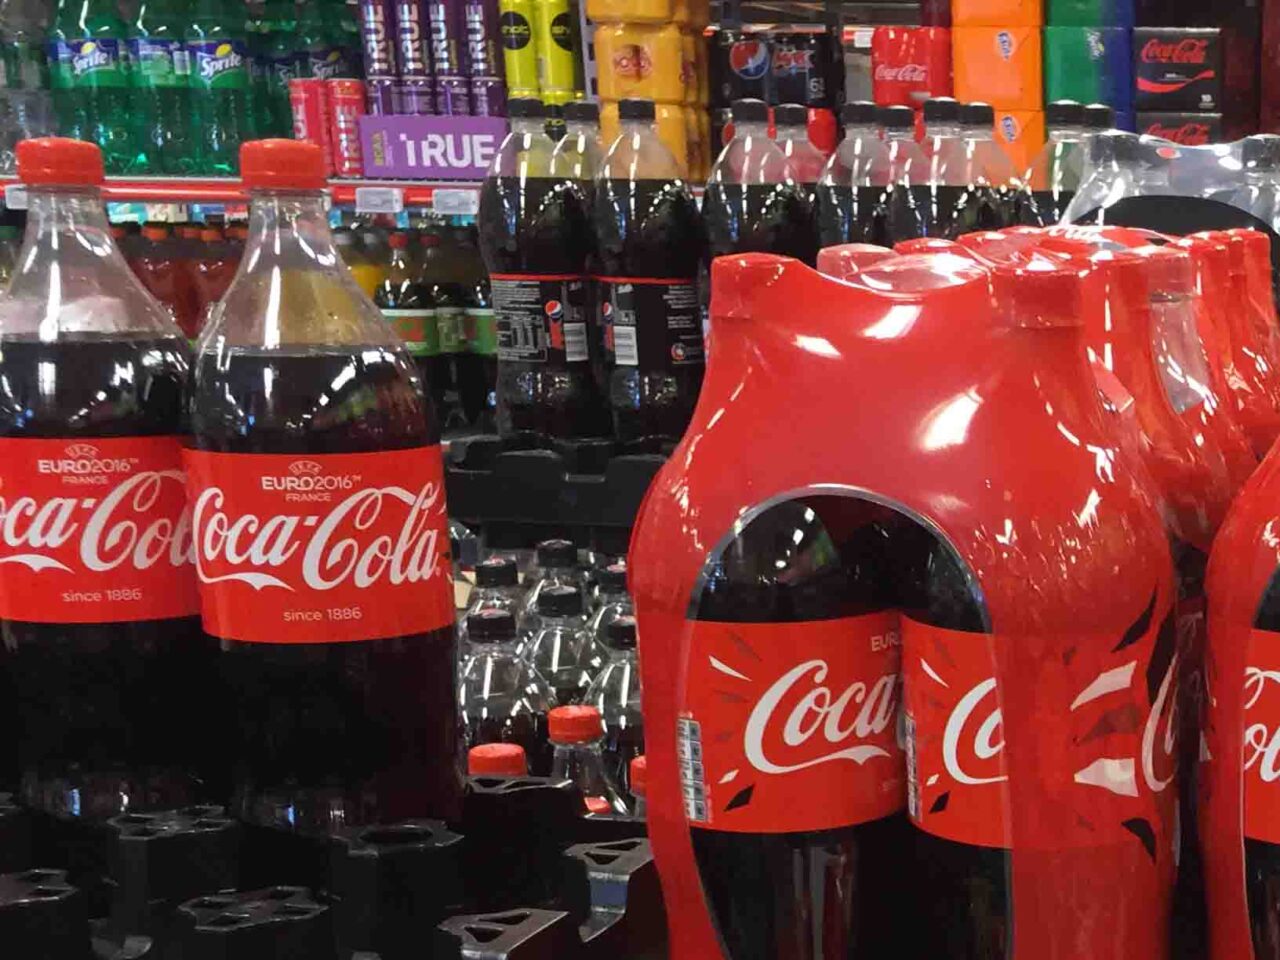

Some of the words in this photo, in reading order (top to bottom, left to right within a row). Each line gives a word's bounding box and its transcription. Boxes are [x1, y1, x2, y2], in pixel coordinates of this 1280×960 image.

[73, 52, 109, 75] Sprite
[200, 54, 243, 75] Sprite
[874, 64, 927, 81] Coca-Cola
[399, 133, 495, 168] TRUE
[285, 492, 332, 502] FRANCE
[62, 590, 103, 602] since
[106, 588, 143, 602] 1886
[283, 610, 323, 622] since
[326, 606, 363, 621] 1886
